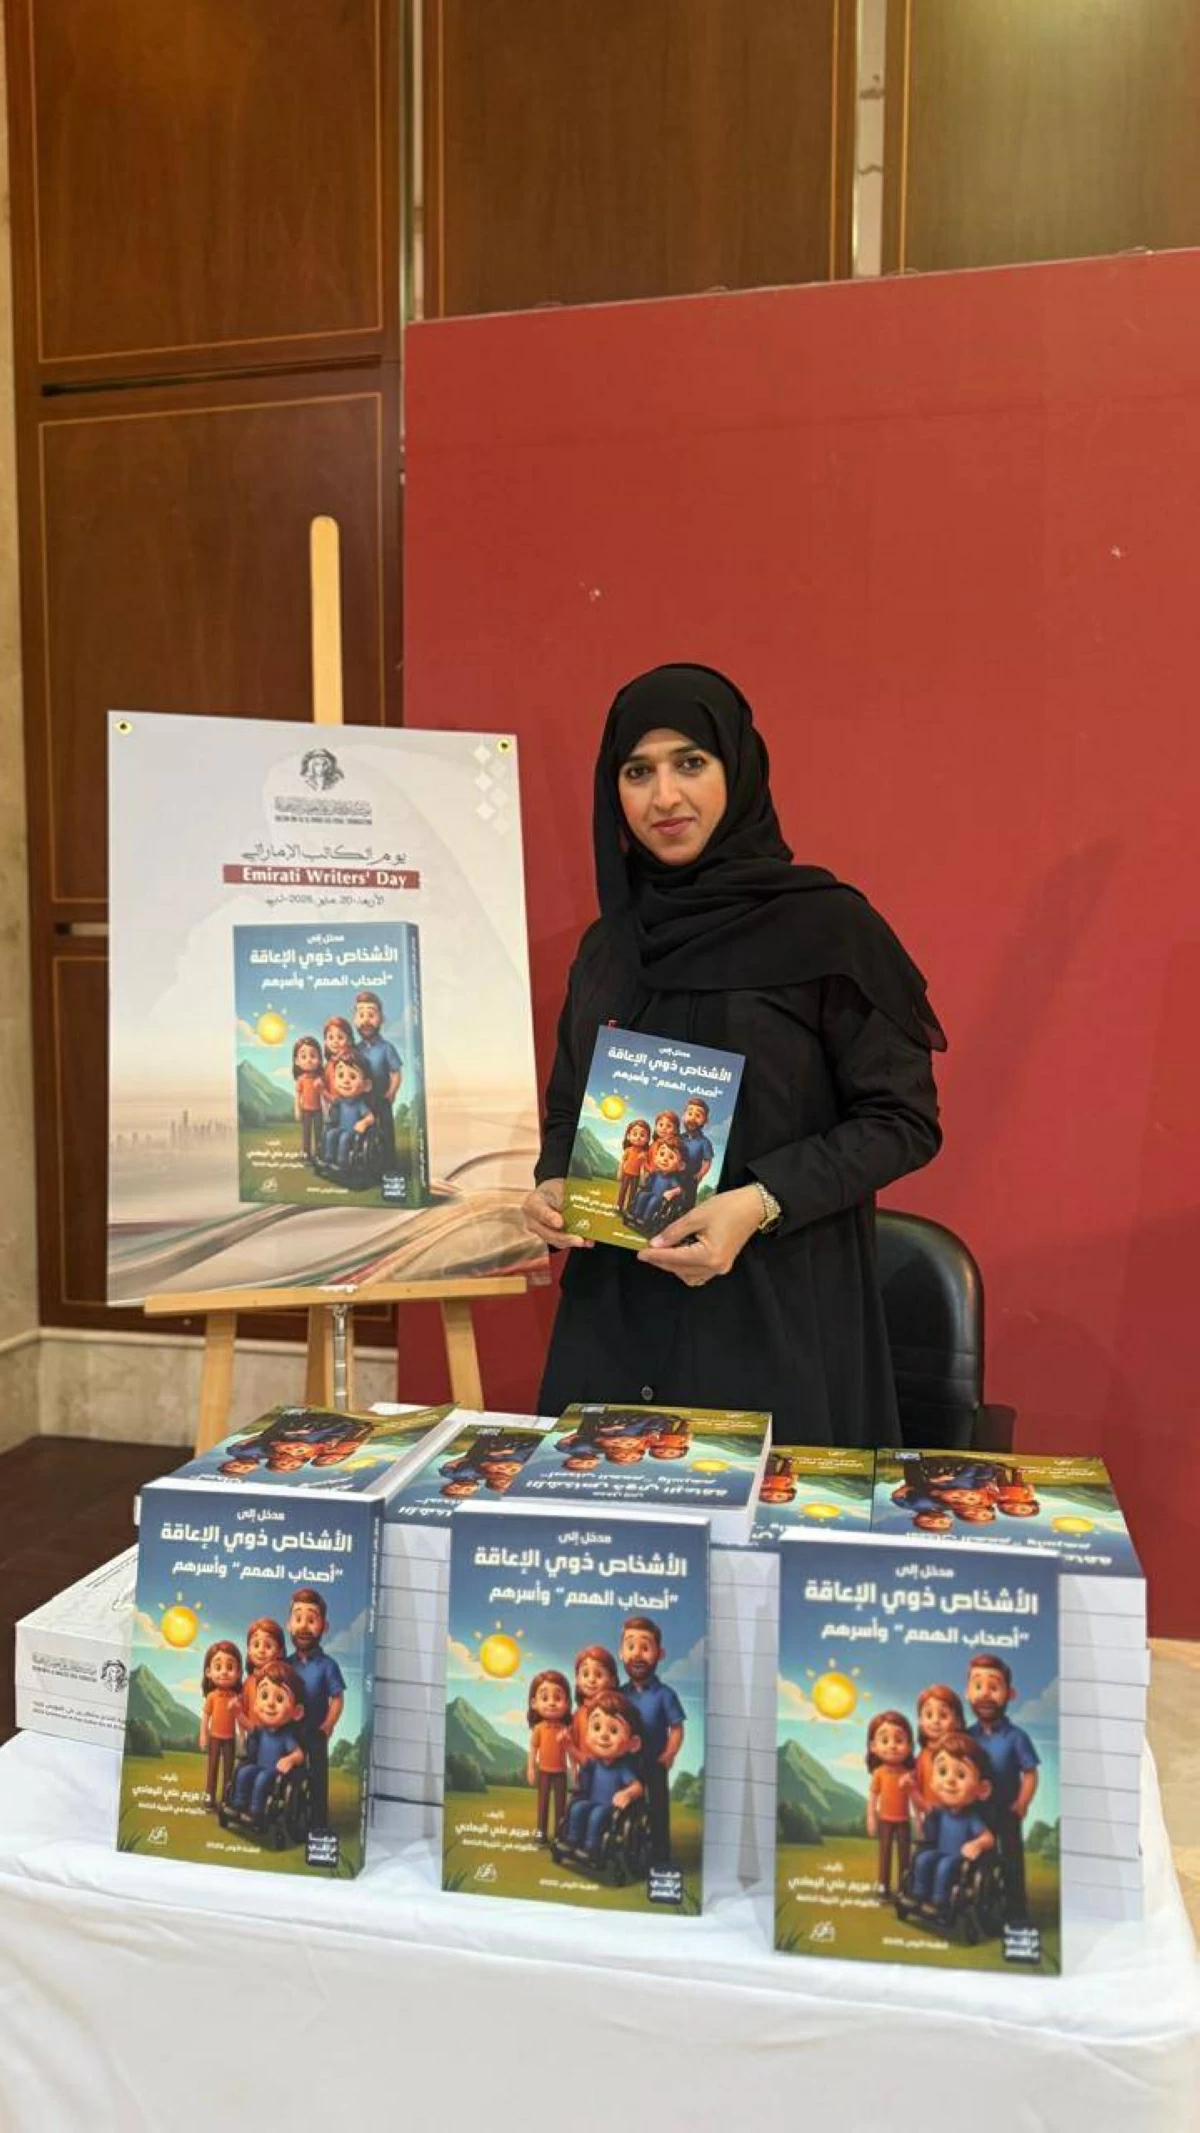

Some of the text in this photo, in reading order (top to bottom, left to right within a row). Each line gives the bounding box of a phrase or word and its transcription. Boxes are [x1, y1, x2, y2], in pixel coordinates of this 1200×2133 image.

[301, 844, 373, 862] الكاتب
[366, 852, 407, 866] يوم
[242, 867, 408, 888] Emirati Writers' Day
[251, 944, 399, 969] الأشخاص ذوي الإعاقة
[261, 971, 304, 990] وأسرهم
[608, 1046, 732, 1082] الأشخاص ذوي الإعاقة
[612, 1069, 649, 1086] وأسرهم
[237, 1508, 285, 1522] مدخل إلى
[161, 1522, 353, 1553] الأشخاص ذوي الإعاقة
[558, 1530, 612, 1546] مدخل إلى
[172, 1554, 227, 1578] وأسرهم
[474, 1545, 688, 1579] الأشخاص ذوي الإعاقة
[894, 1562, 955, 1580] مدخل إلى
[488, 1579, 551, 1607] وأسرهم
[804, 1578, 1039, 1615] الأشخاص ذوي الإعاقة
[821, 1617, 889, 1644] وأسرهم
